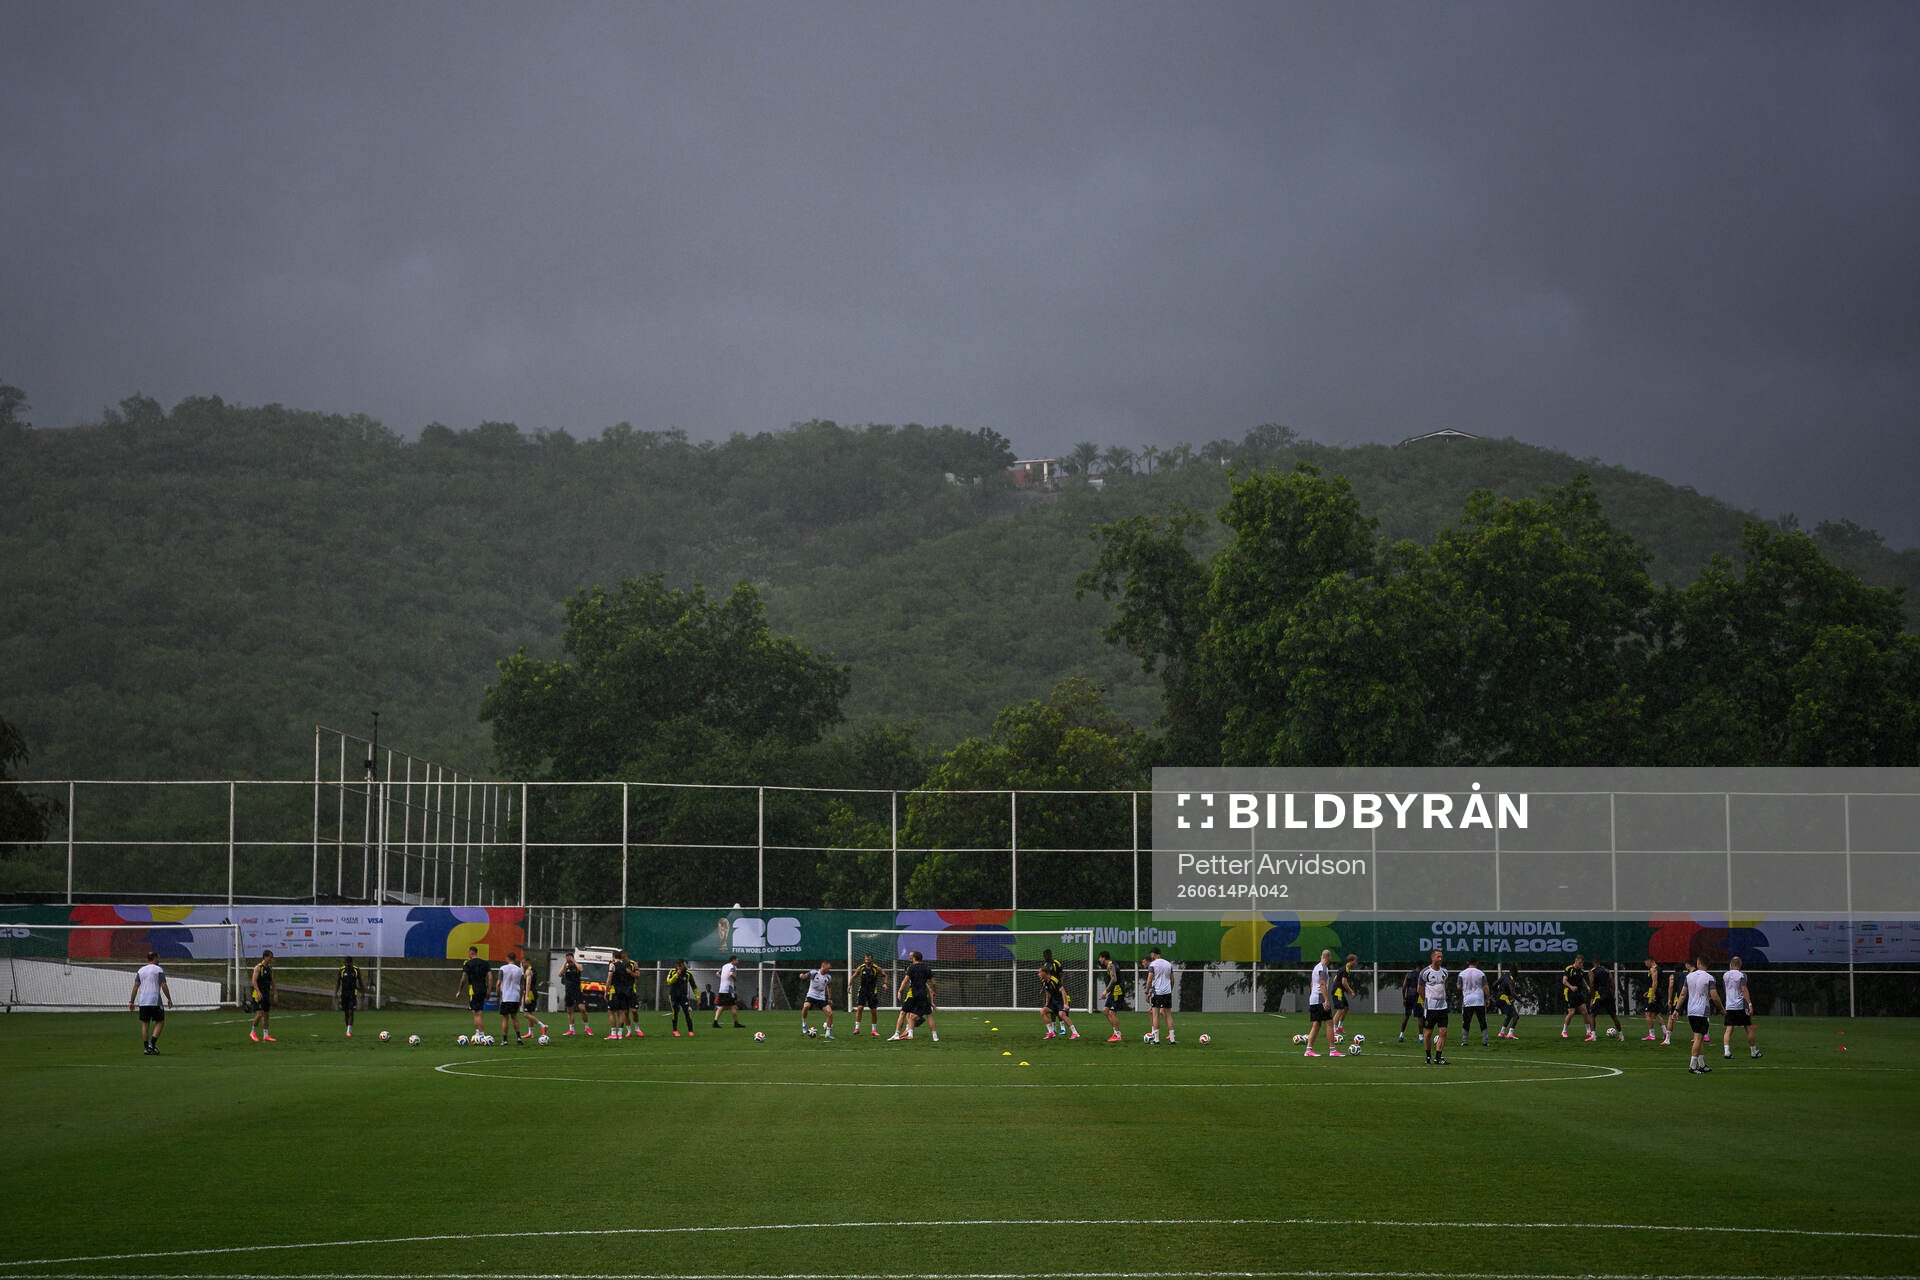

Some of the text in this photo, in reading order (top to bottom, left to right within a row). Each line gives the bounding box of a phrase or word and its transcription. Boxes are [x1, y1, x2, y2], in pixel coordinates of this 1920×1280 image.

[1431, 921, 1565, 935] COPA MUNDIAL
[1419, 937, 1578, 953] DE LA FIFA 2026
